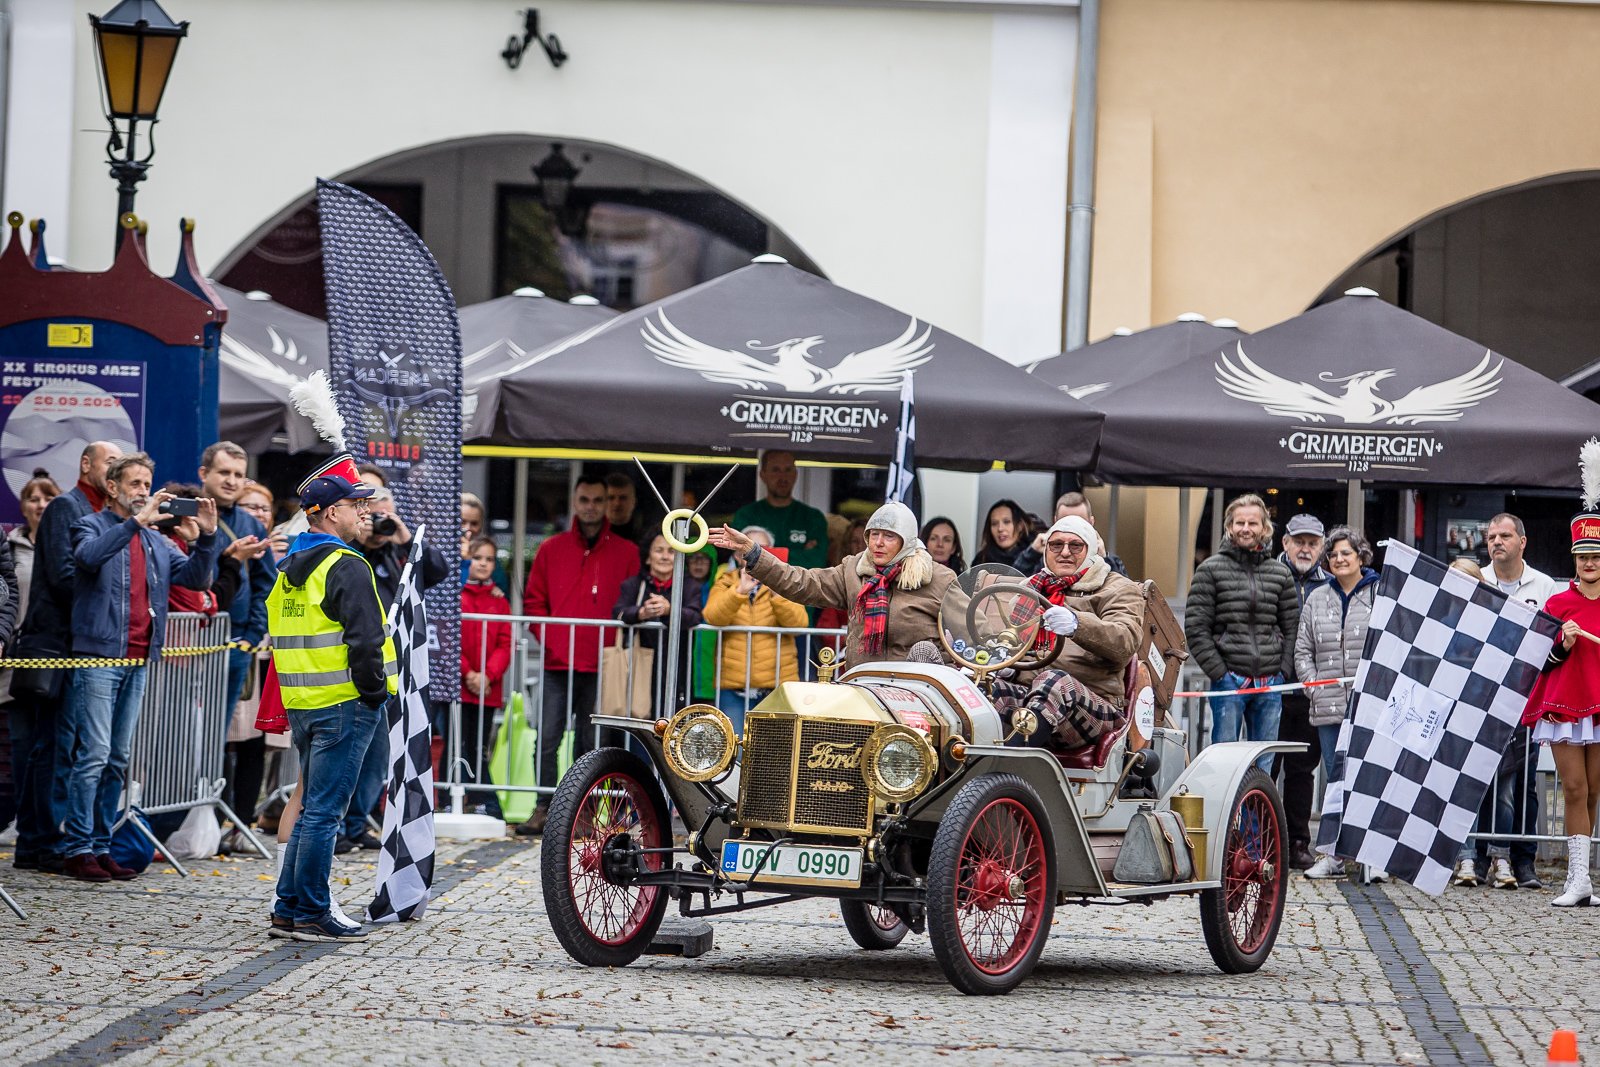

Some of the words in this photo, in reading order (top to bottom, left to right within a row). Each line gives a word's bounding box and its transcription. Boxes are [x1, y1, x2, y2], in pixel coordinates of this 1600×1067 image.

[3, 362, 26, 373] XX
[33, 363, 98, 376] KROKUS
[100, 365, 140, 376] JAZZ
[729, 400, 880, 428] GRIMBERGEN
[790, 431, 813, 443] 1128
[1288, 432, 1435, 457] GRIMBERGEN
[1348, 461, 1369, 472] 1128
[1420, 710, 1437, 738] BURGER
[807, 742, 862, 768] Ford
[742, 848, 781, 871] 08V
[798, 852, 850, 876] 0990
